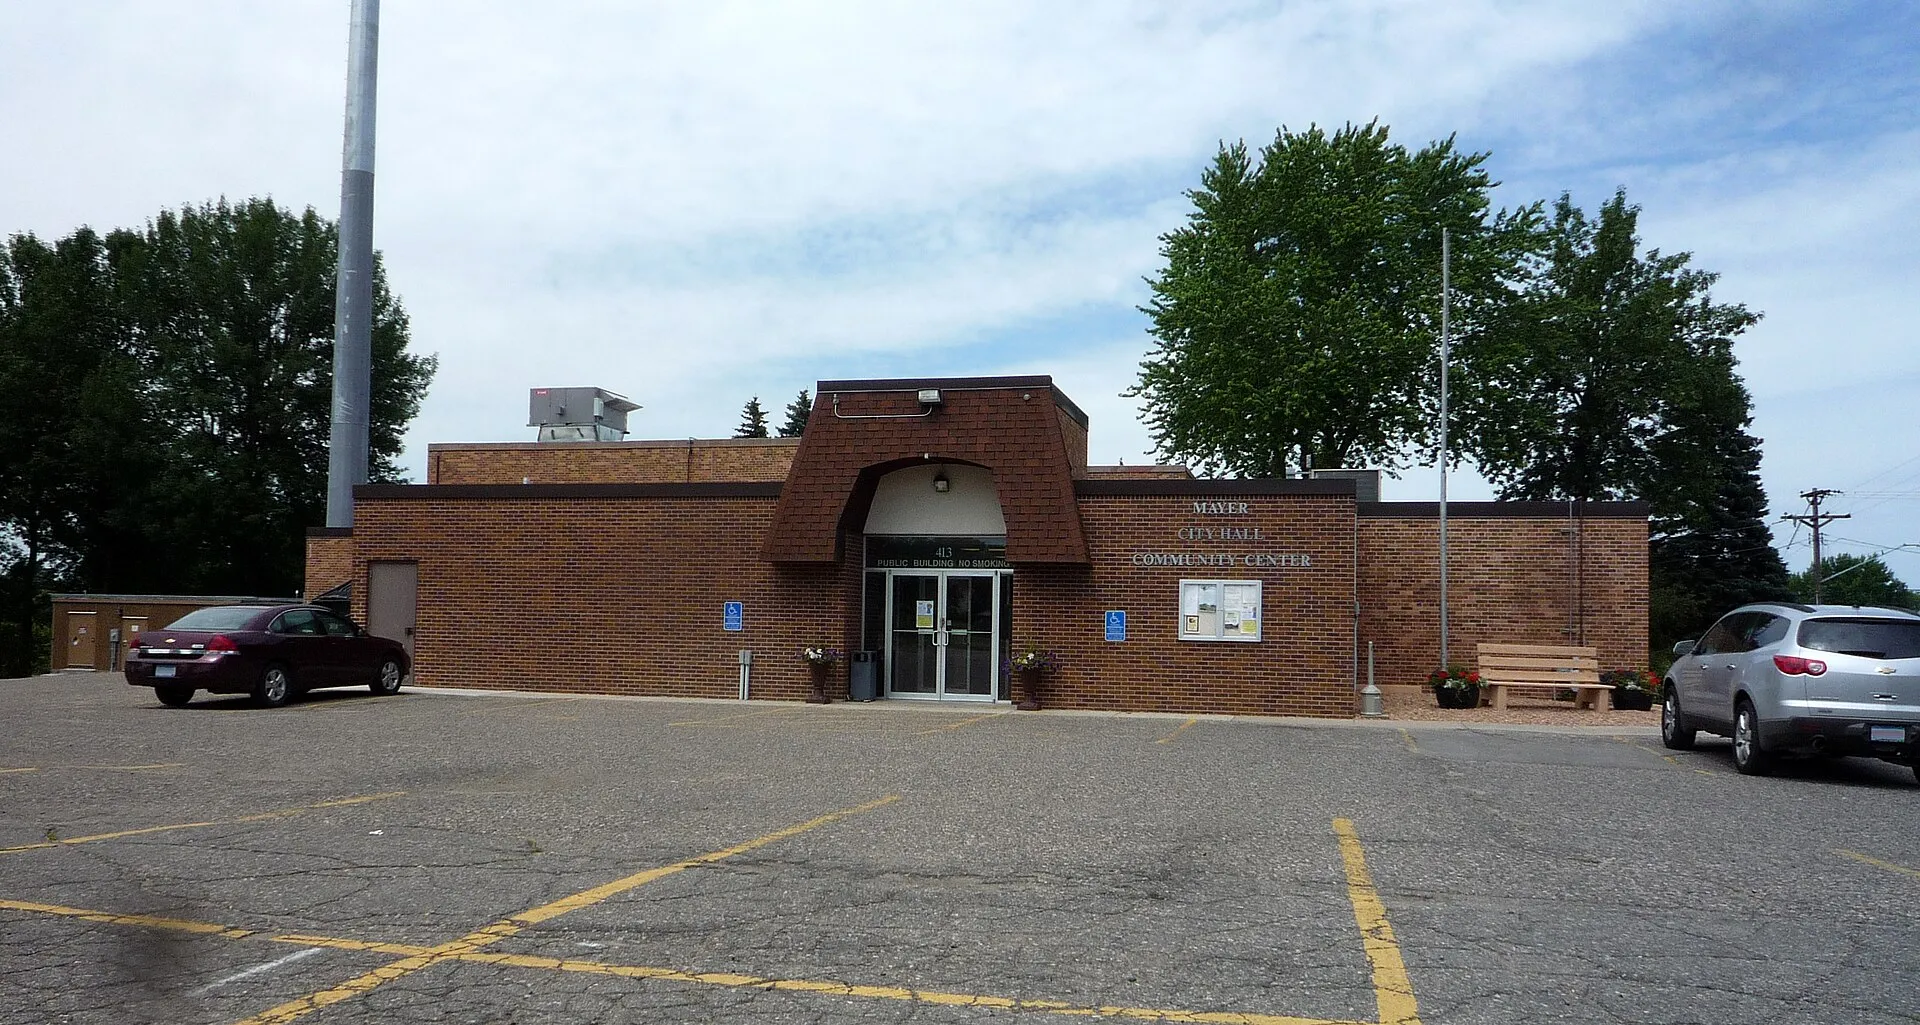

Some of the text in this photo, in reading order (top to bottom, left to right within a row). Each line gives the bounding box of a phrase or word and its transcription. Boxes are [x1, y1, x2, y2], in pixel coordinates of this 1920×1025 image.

[1192, 502, 1249, 514] MAYER
[1177, 528, 1264, 540] CITY HALL
[936, 547, 953, 558] 413
[877, 559, 909, 567] PUBLIC
[913, 559, 954, 567] BUILDING
[958, 559, 971, 568] NO
[1132, 553, 1312, 567] COMMUNITY CENTER
